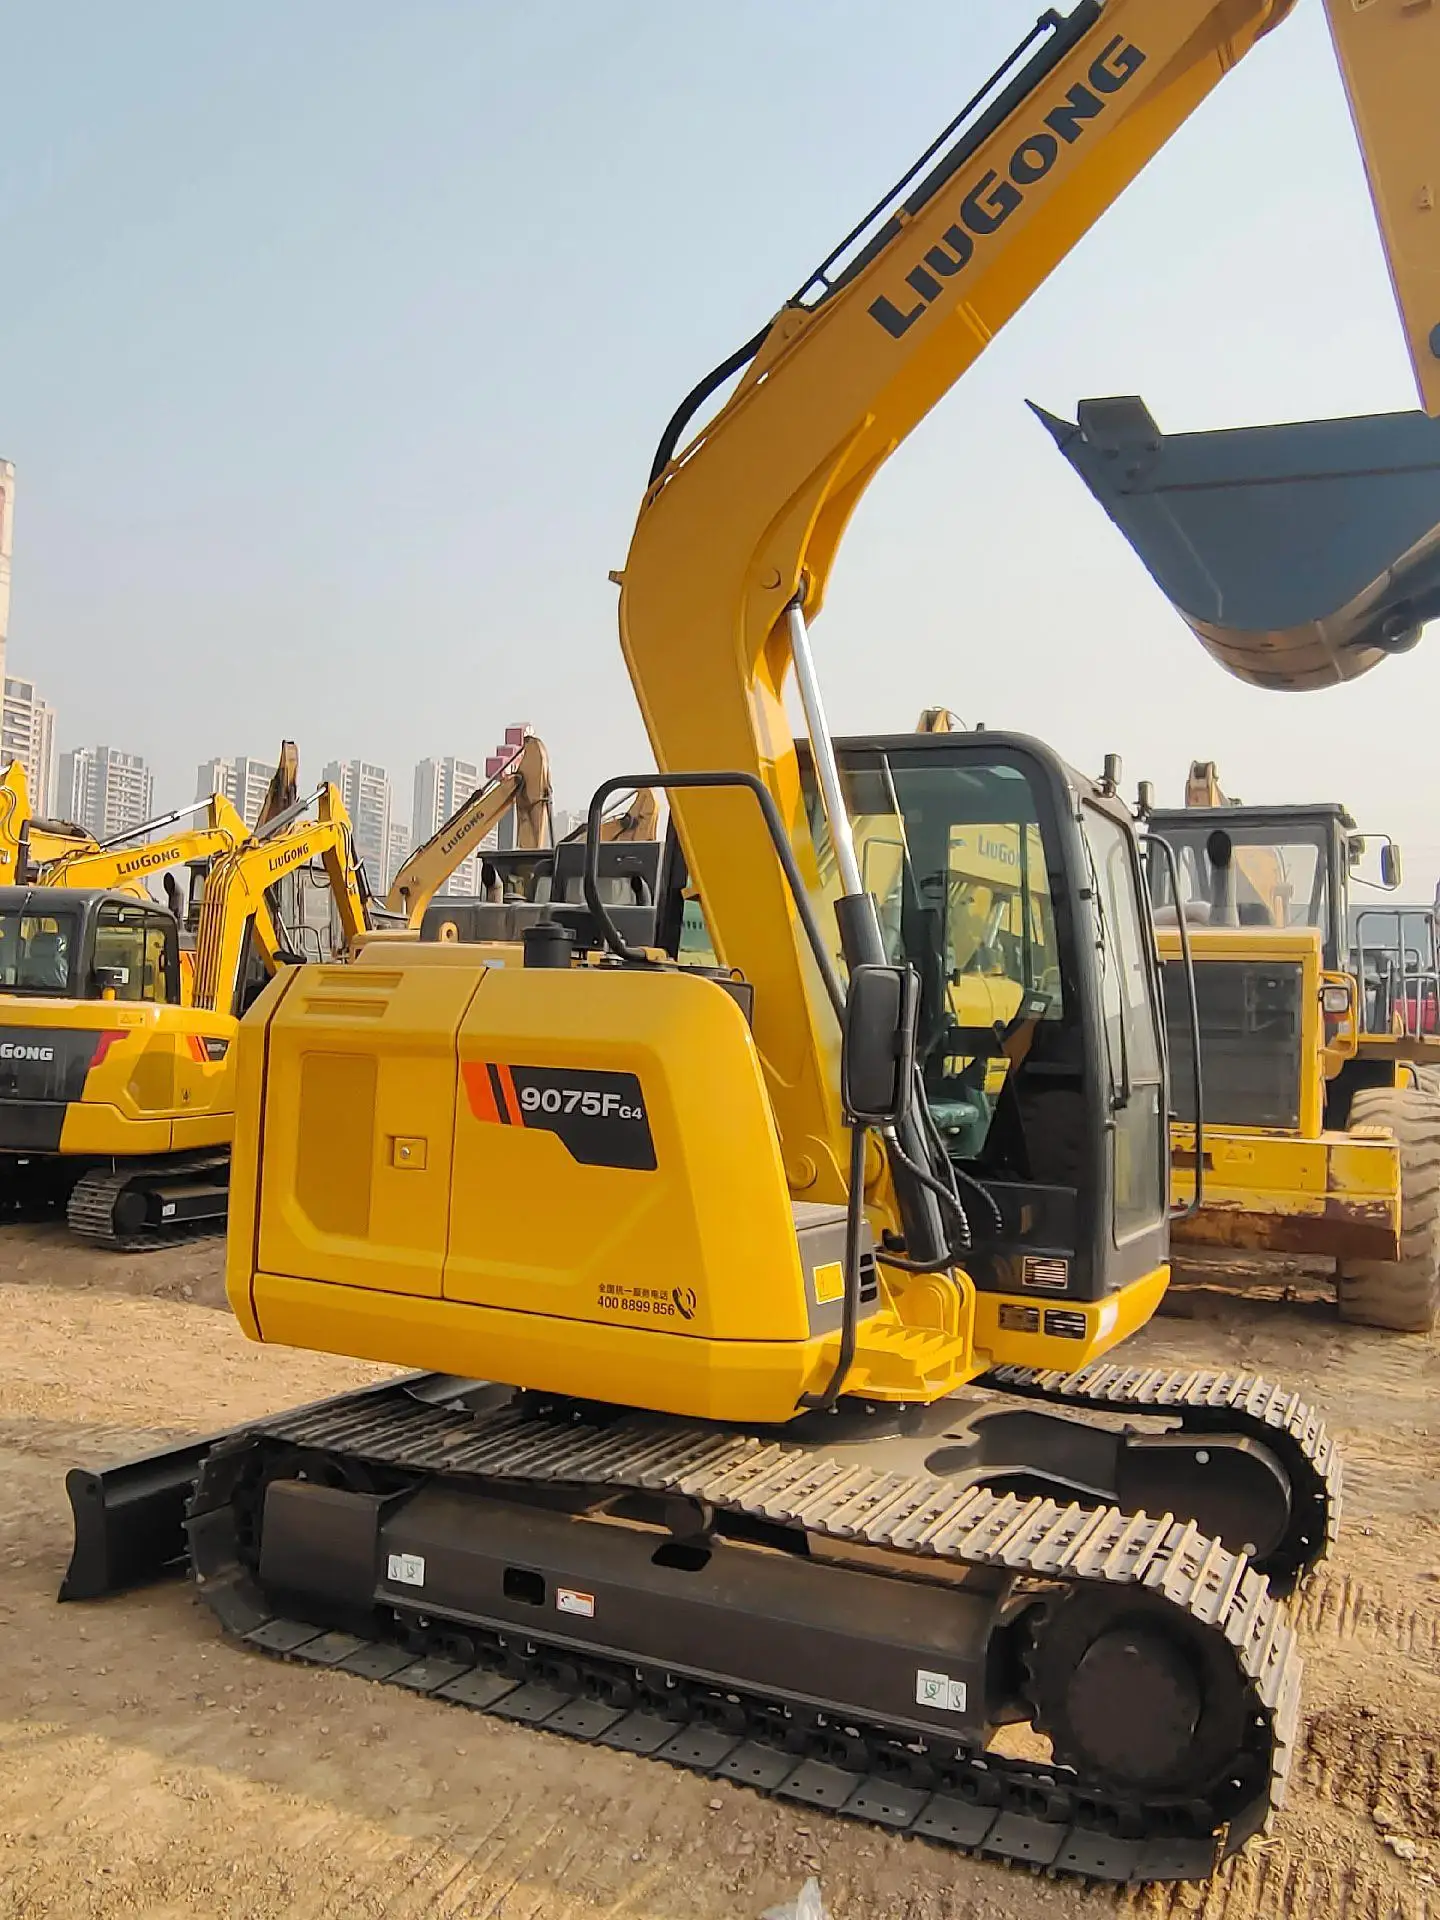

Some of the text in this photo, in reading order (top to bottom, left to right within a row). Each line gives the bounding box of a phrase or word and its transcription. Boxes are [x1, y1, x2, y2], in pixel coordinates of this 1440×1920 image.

[867, 34, 1146, 338] LIUGONG
[441, 811, 485, 854] LIUGONG
[116, 848, 180, 874] LIUGONG
[268, 843, 309, 871] LIUGONG
[598, 1296, 675, 1315] 400 8899 856
